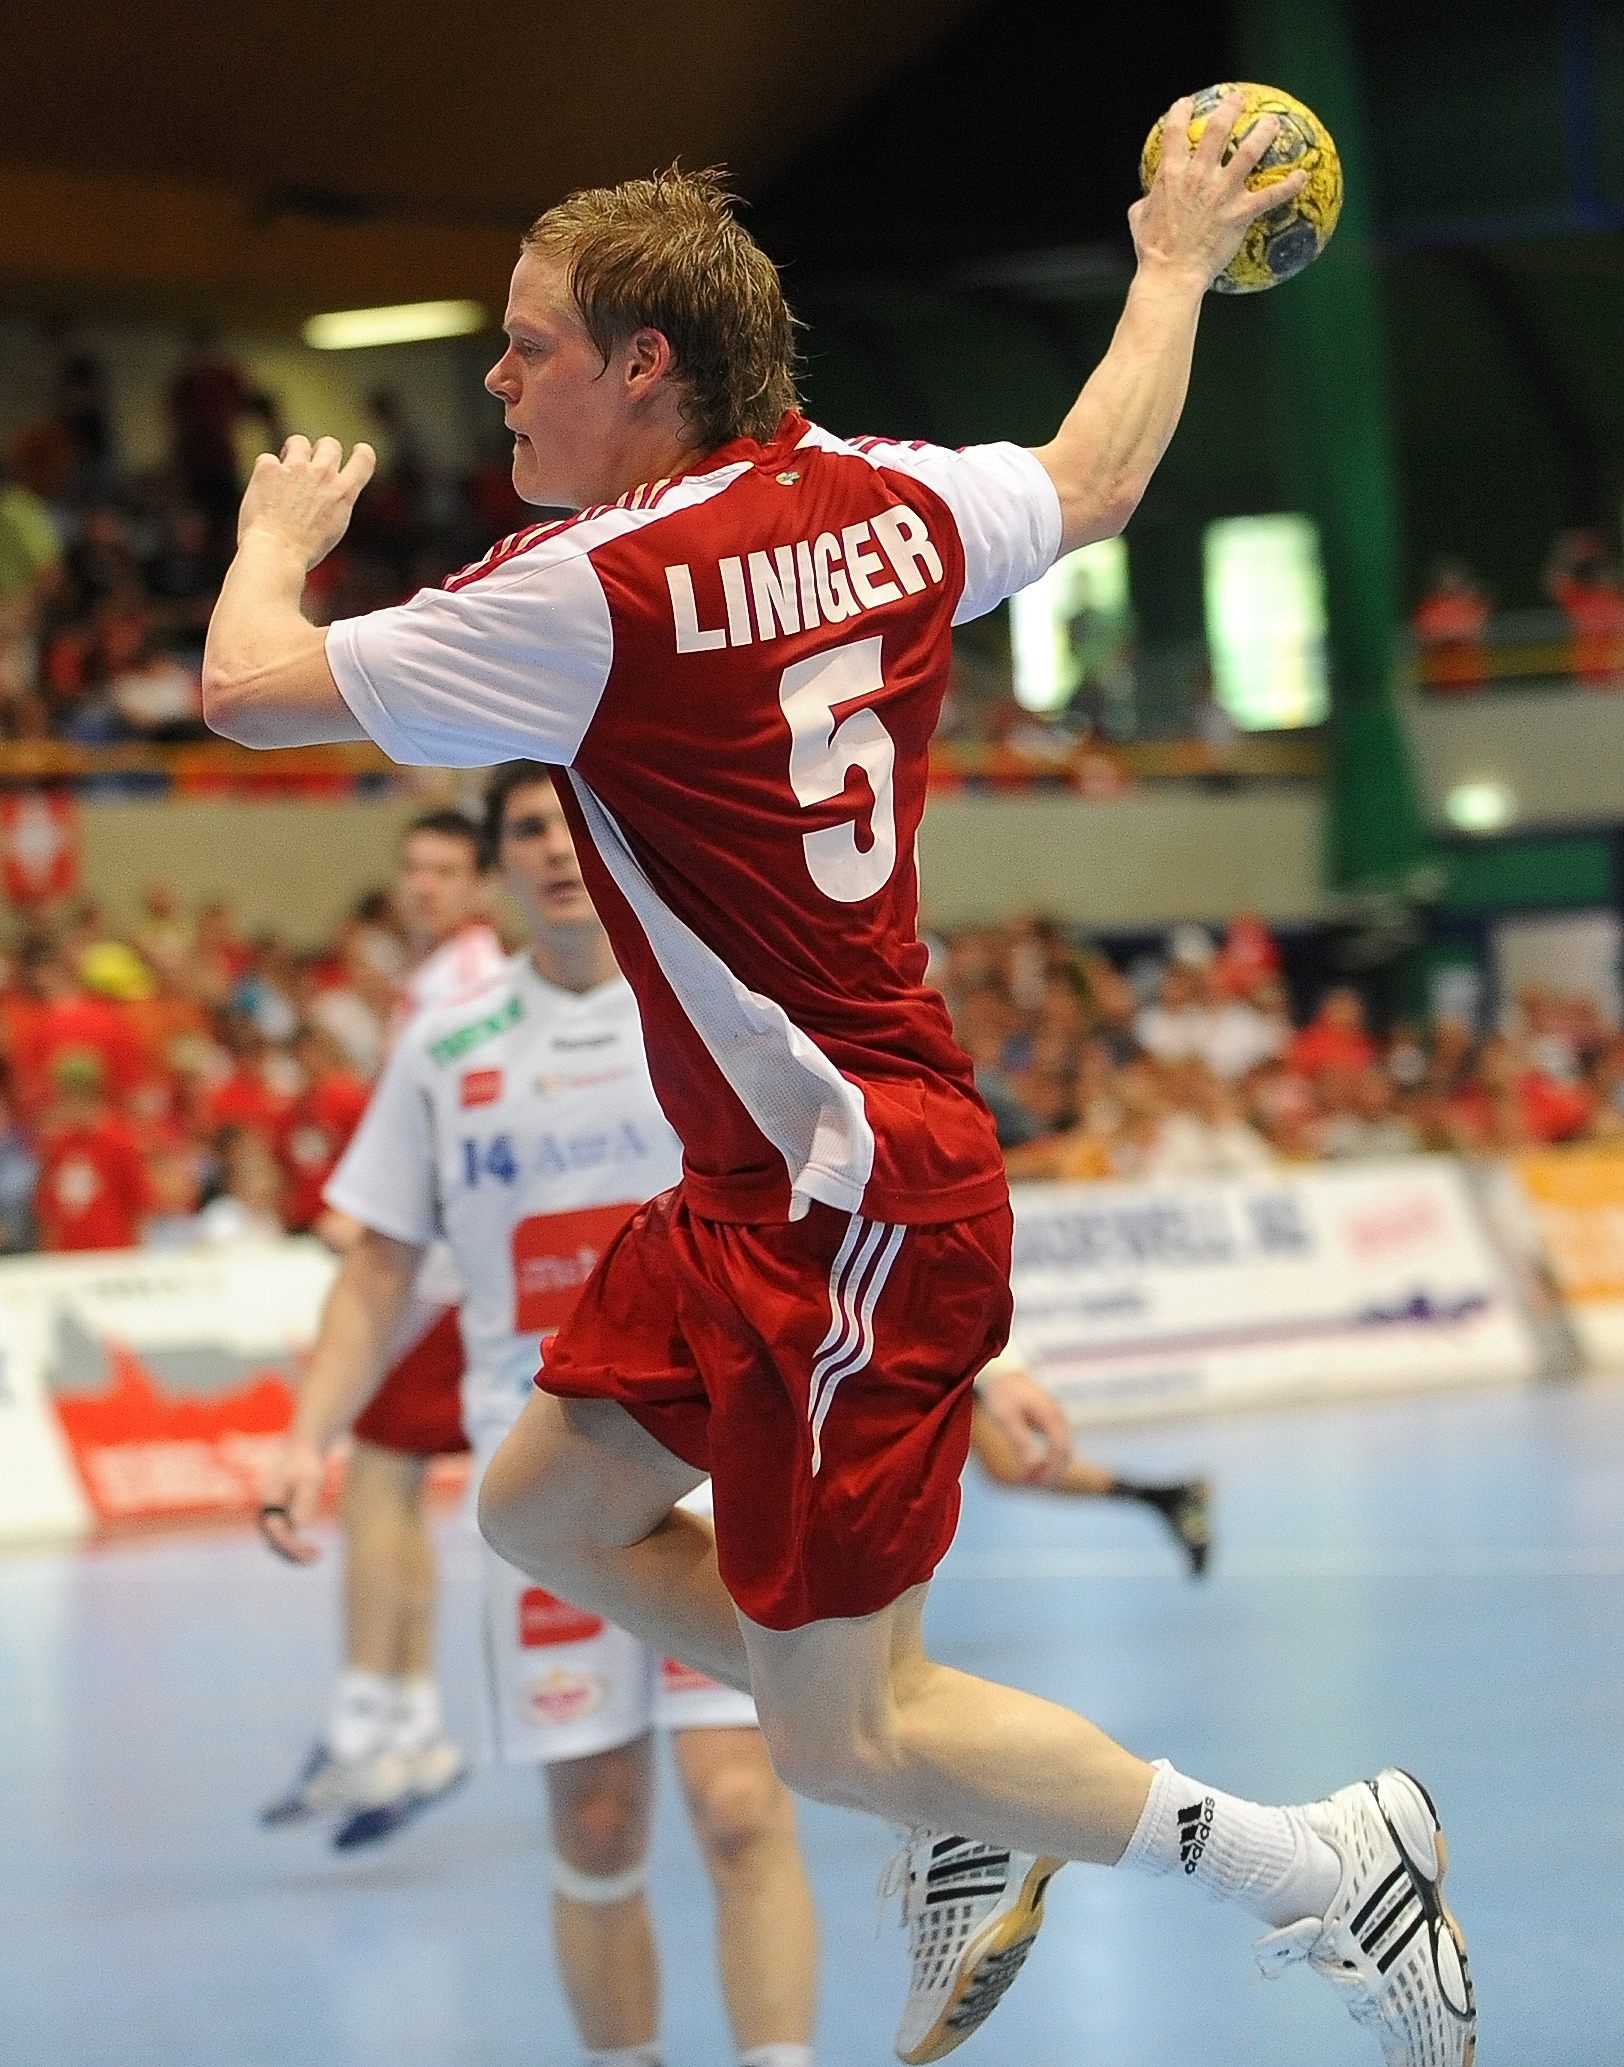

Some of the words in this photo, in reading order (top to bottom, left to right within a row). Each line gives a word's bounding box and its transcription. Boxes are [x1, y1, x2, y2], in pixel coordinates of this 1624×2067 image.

[664, 504, 944, 654] LINIGER
[779, 634, 897, 903] 5
[462, 1133, 518, 1187] 14
[1184, 1796, 1216, 1875] adidas
